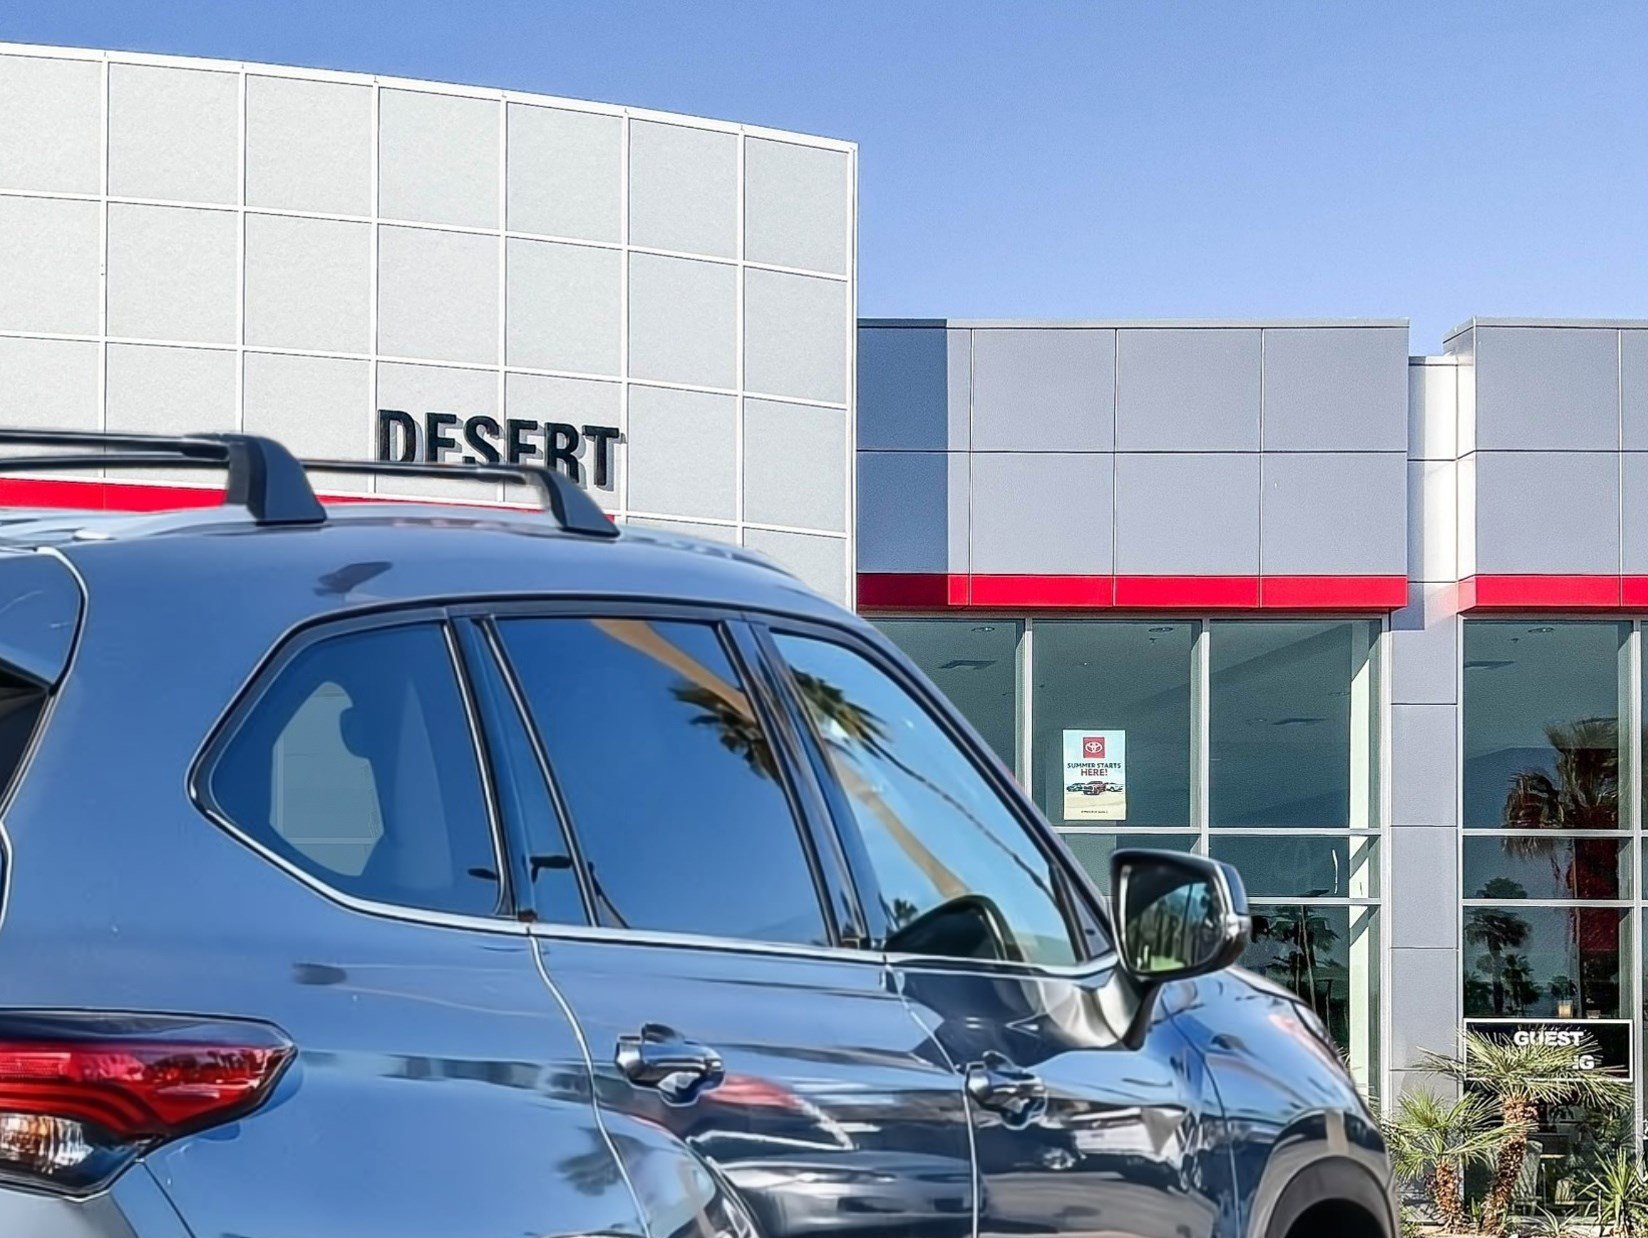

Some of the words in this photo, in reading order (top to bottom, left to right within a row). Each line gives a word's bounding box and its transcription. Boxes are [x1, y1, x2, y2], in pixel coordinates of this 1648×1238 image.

[377, 409, 621, 487] DESERT
[1080, 768, 1108, 776] HERE!
[1513, 1030, 1585, 1047] GUEST
